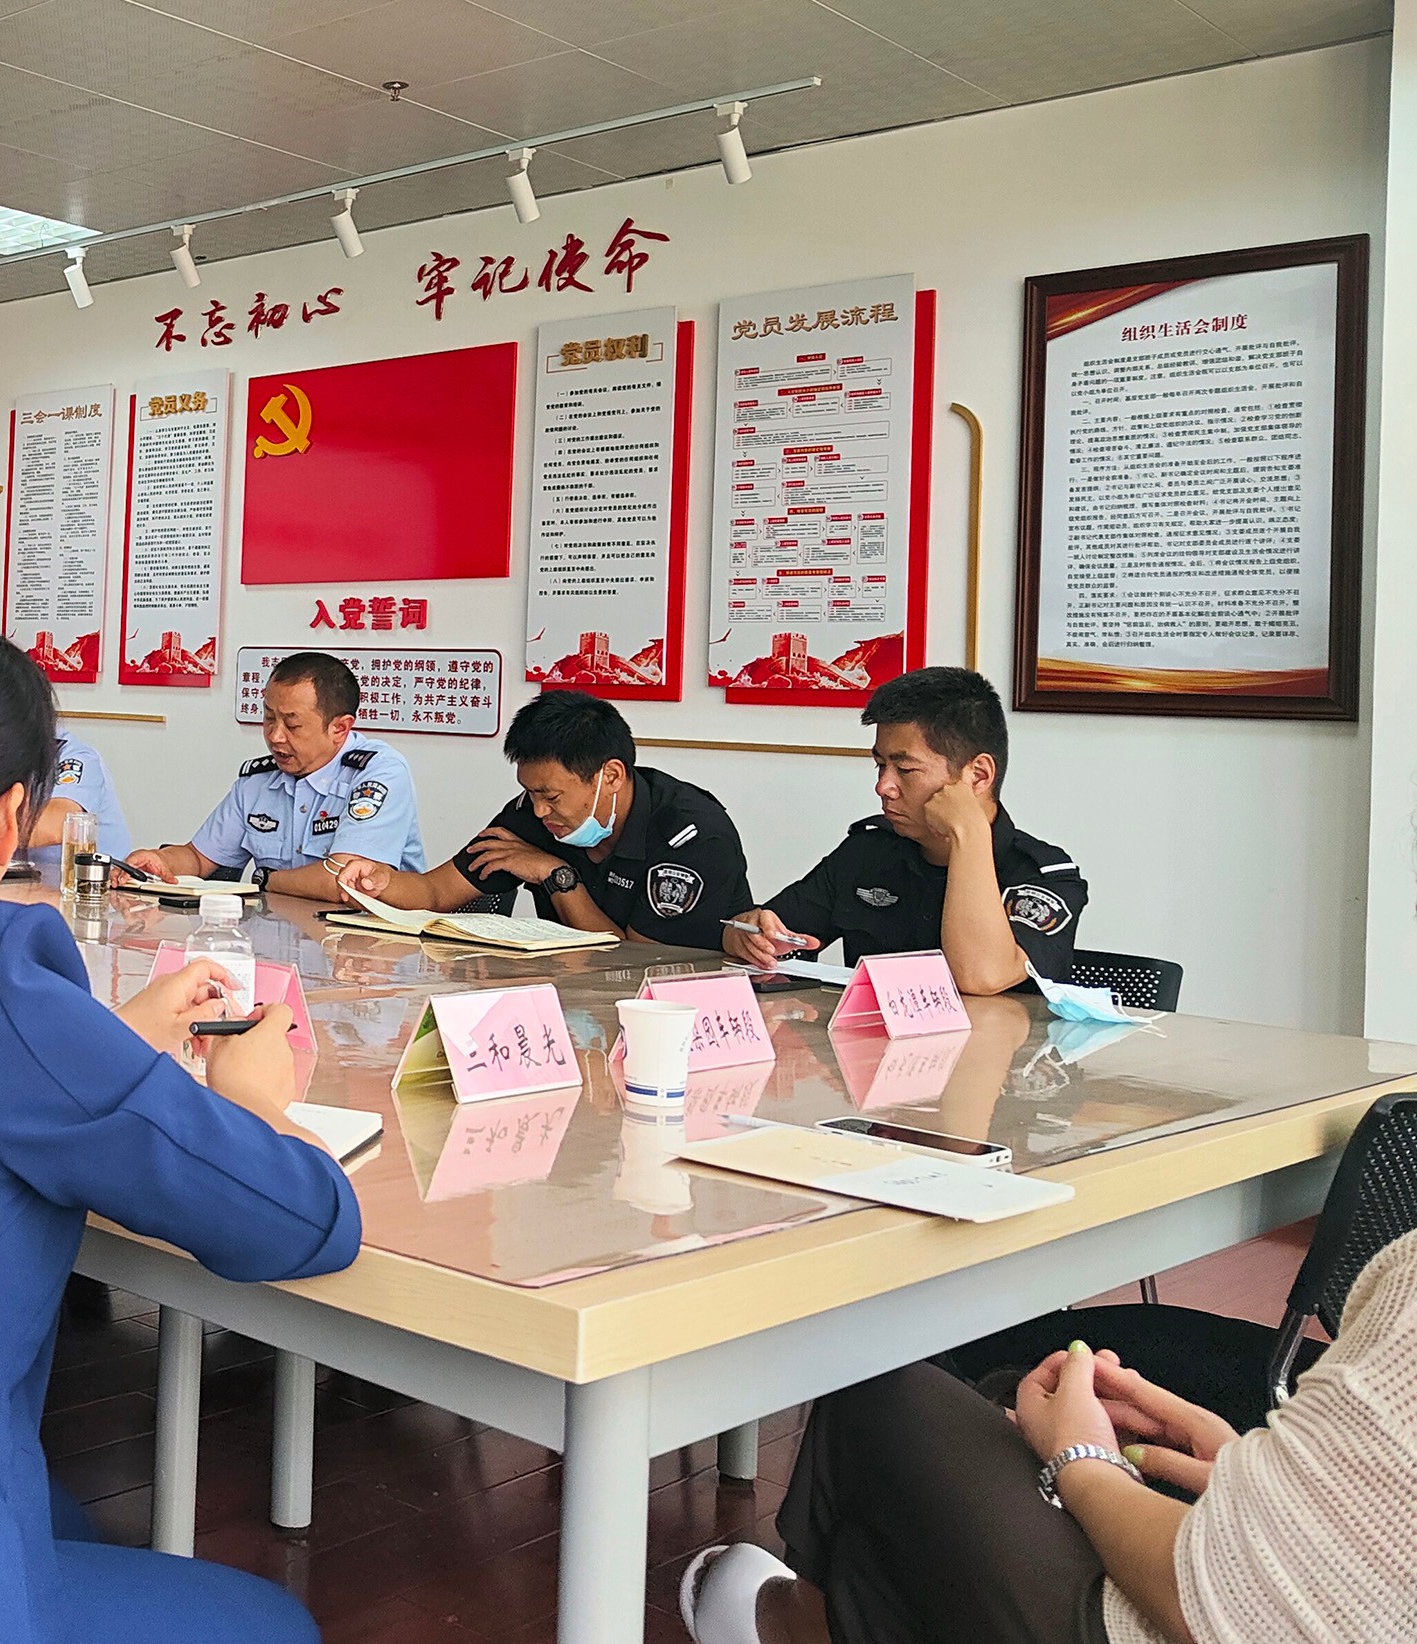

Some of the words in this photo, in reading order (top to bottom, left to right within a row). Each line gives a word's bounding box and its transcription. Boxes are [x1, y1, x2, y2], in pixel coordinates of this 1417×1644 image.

[415, 217, 670, 320] 牢记使命
[154, 287, 345, 352] 不忘初心
[732, 302, 898, 340] 党员发展流程
[1121, 314, 1249, 342] 组织生活会制度
[559, 334, 649, 366] 党员权利
[20, 403, 103, 425] 三会一课制度
[148, 391, 208, 417] 党员义务
[310, 596, 429, 630] 入党誓词
